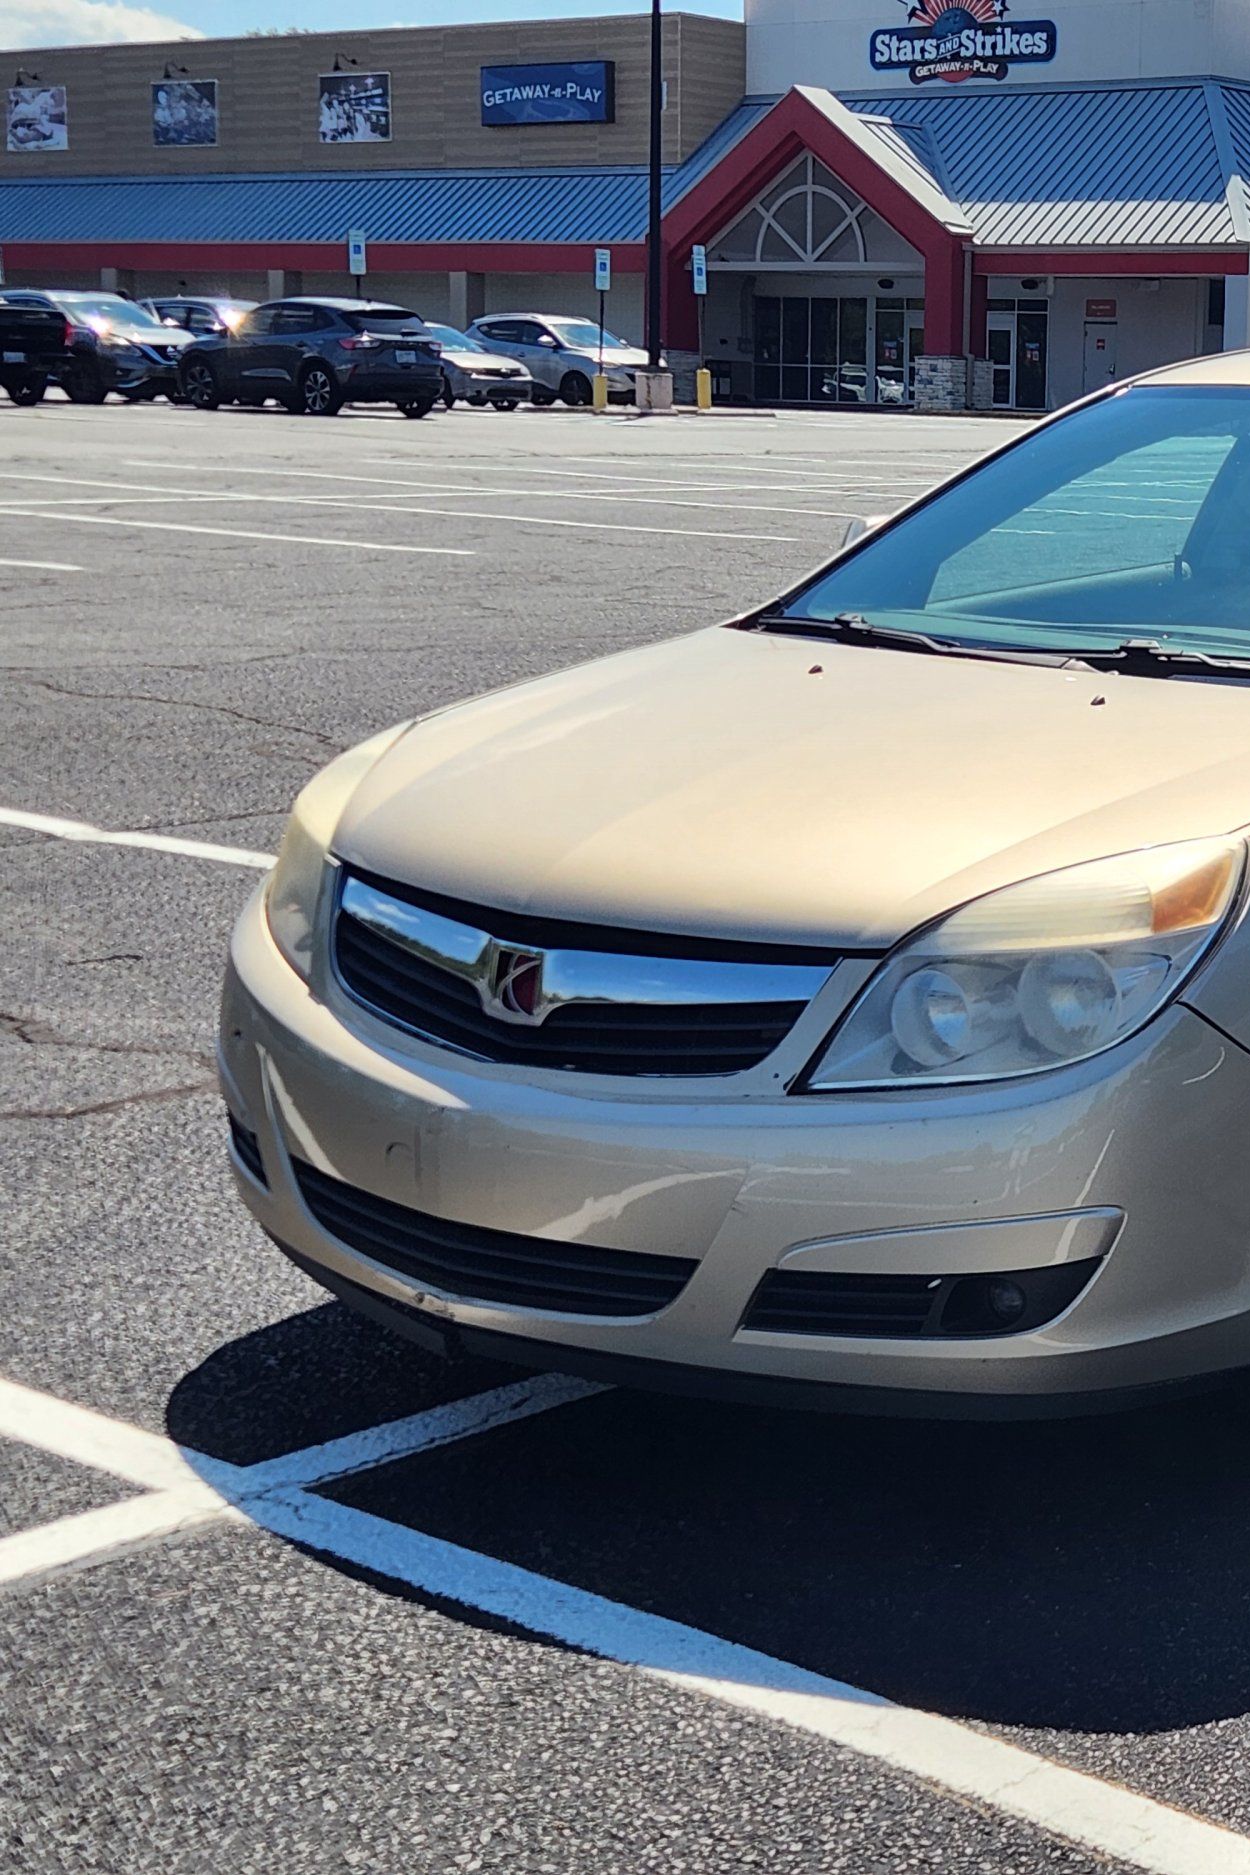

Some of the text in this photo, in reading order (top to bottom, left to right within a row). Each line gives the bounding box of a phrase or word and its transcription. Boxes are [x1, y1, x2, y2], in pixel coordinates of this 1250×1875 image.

[875, 27, 1048, 63] Stars AND Strikes
